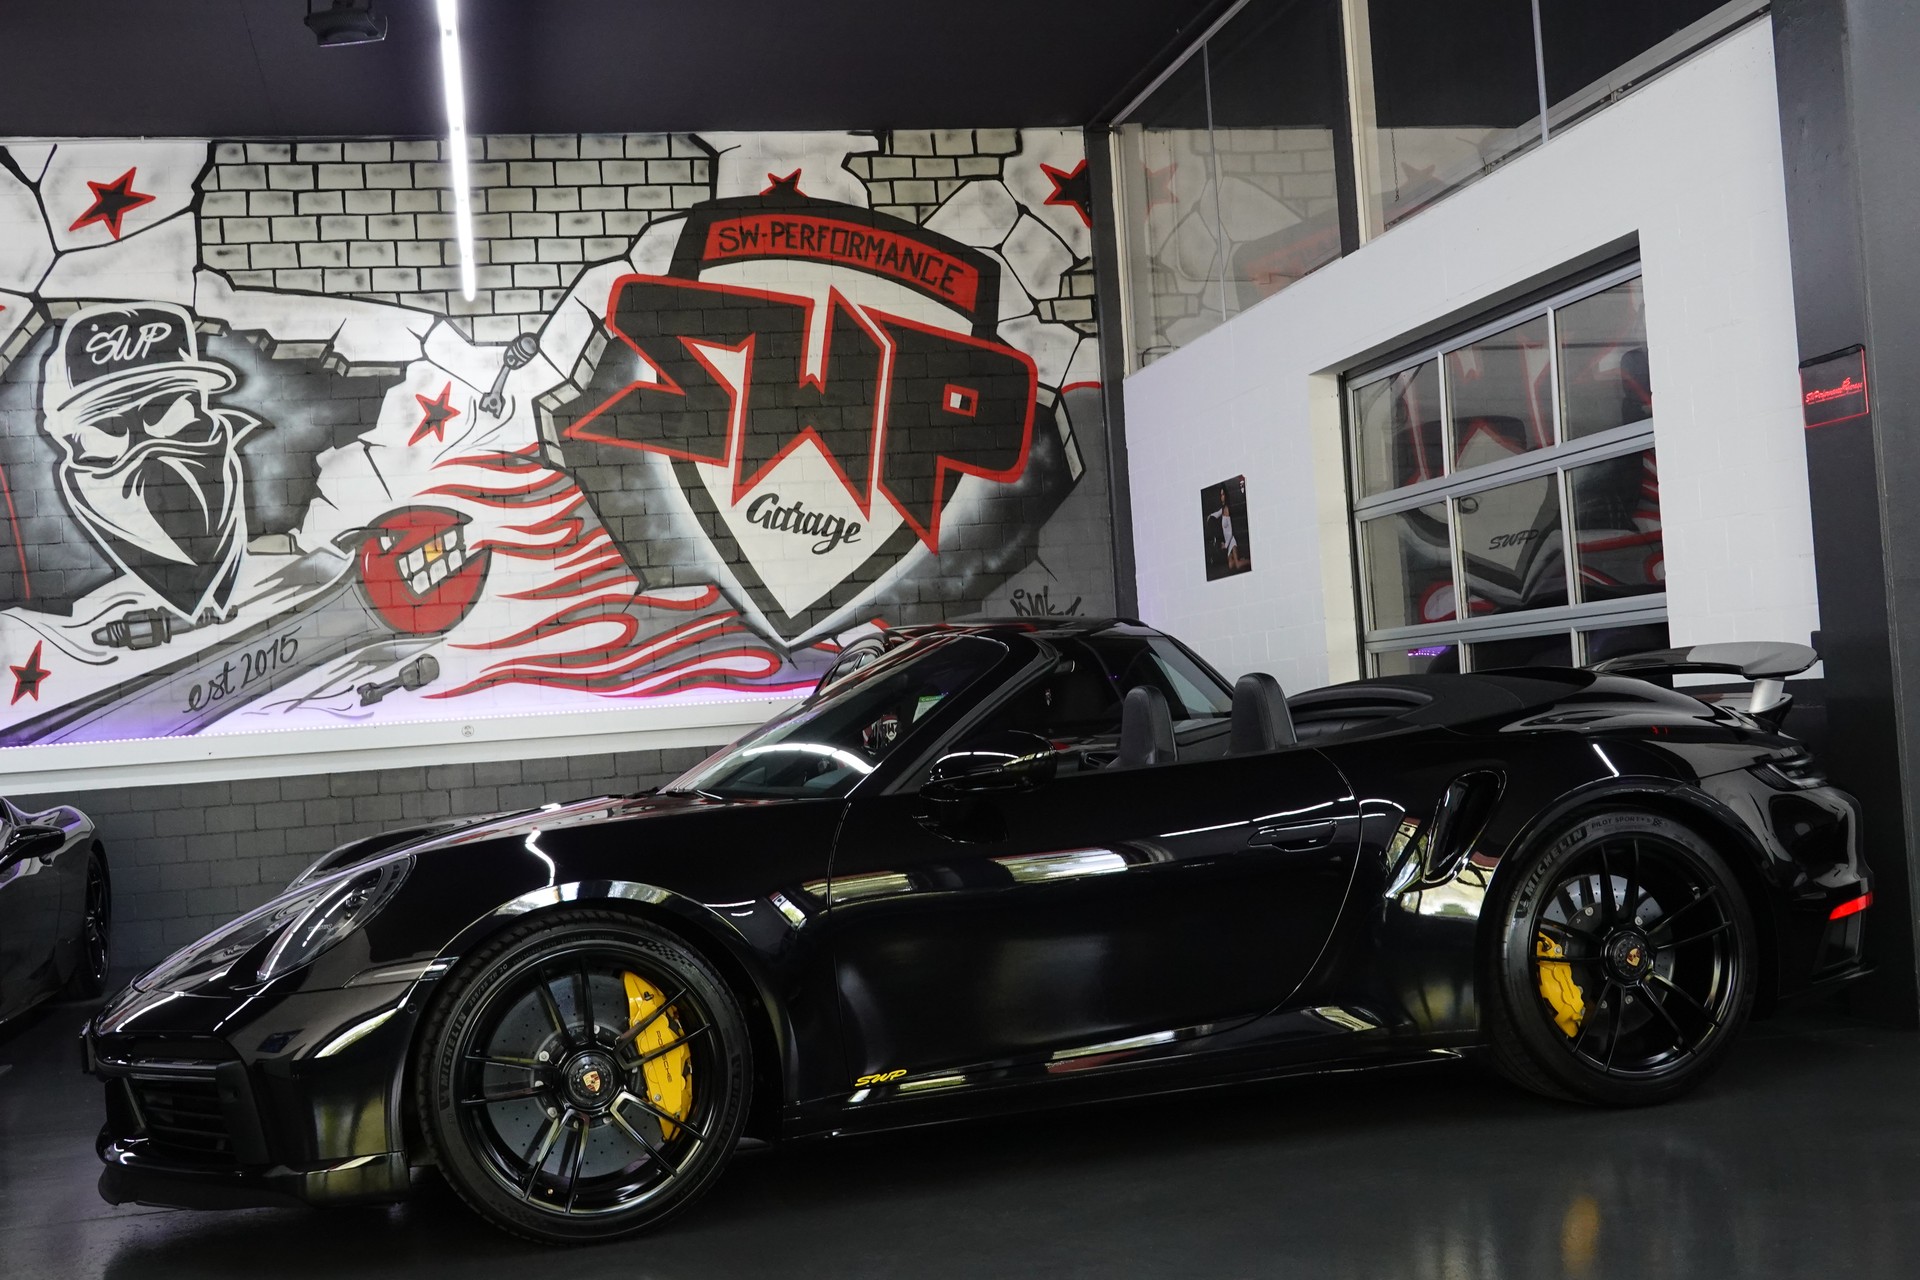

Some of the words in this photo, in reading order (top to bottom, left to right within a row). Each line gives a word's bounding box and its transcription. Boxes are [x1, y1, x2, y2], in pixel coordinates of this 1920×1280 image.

[718, 220, 964, 296] SW-PERFORMANCE
[85, 322, 172, 365] SWP
[563, 273, 1039, 555] SWP
[746, 492, 862, 555] Garage
[182, 661, 236, 713] est
[240, 626, 302, 689] 2015
[1525, 827, 1586, 895] MICHELIN
[440, 1012, 468, 1088] MICHELIN
[656, 1030, 673, 1083] POSCHE
[854, 1069, 908, 1087] SWP
